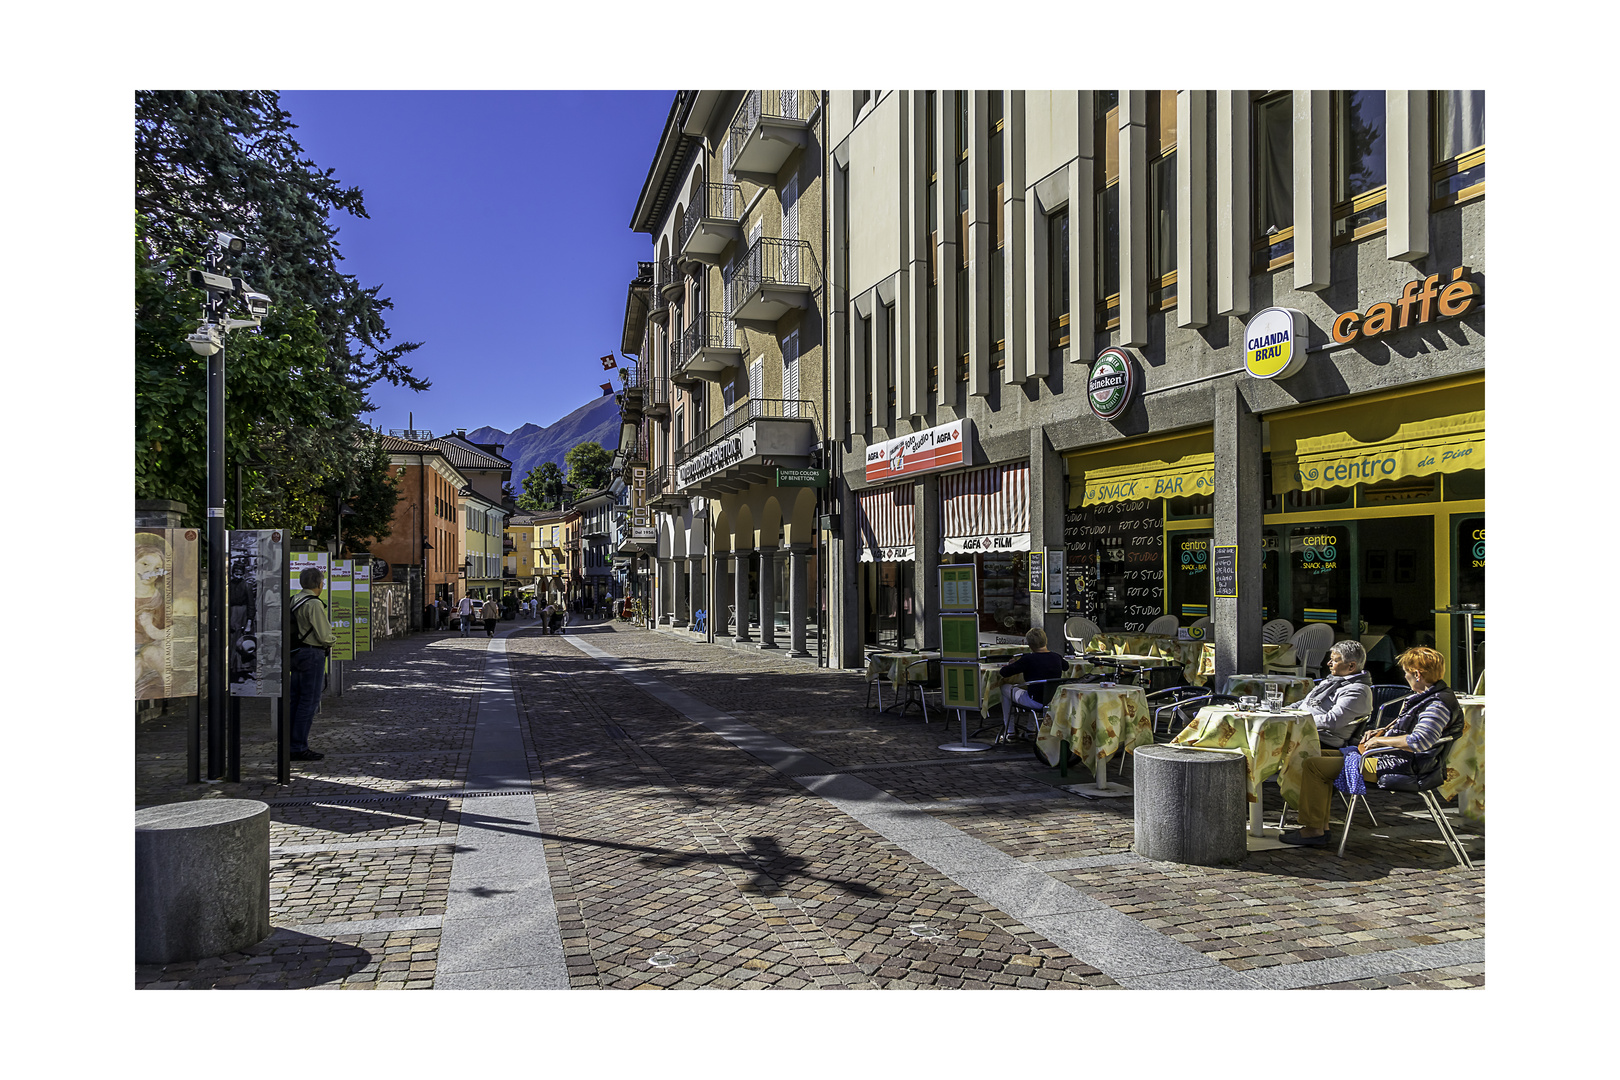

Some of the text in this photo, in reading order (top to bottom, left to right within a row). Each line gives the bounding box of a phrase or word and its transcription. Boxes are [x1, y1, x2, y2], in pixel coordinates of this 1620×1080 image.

[1248, 330, 1289, 350] CALANDA
[1255, 345, 1282, 362] BRÄU
[1090, 375, 1123, 391] Heineken
[905, 435, 916, 450] foto
[912, 433, 929, 453] studio
[929, 431, 934, 446] 1
[936, 432, 952, 444] AGFA
[867, 451, 879, 462] AGFA
[1323, 447, 1474, 482] centro da Pino
[1097, 481, 1139, 501] SNACK
[1155, 476, 1184, 495] BAR
[634, 468, 646, 526] OTTICO
[1094, 504, 1114, 515] FOTO
[1116, 501, 1144, 514] STUDIO
[1080, 525, 1107, 536] STUDIO
[1118, 520, 1140, 531] FOTO
[962, 537, 1012, 550] AGFA FILM
[1131, 536, 1154, 547] FOTO
[1181, 540, 1207, 550] centro
[1303, 535, 1337, 546] centro
[873, 548, 908, 559] AGFA FILM
[1127, 551, 1158, 563] STUDIO
[1325, 561, 1337, 569] BAR
[1127, 586, 1149, 597] FOTO
[1129, 604, 1161, 616] STUDIO
